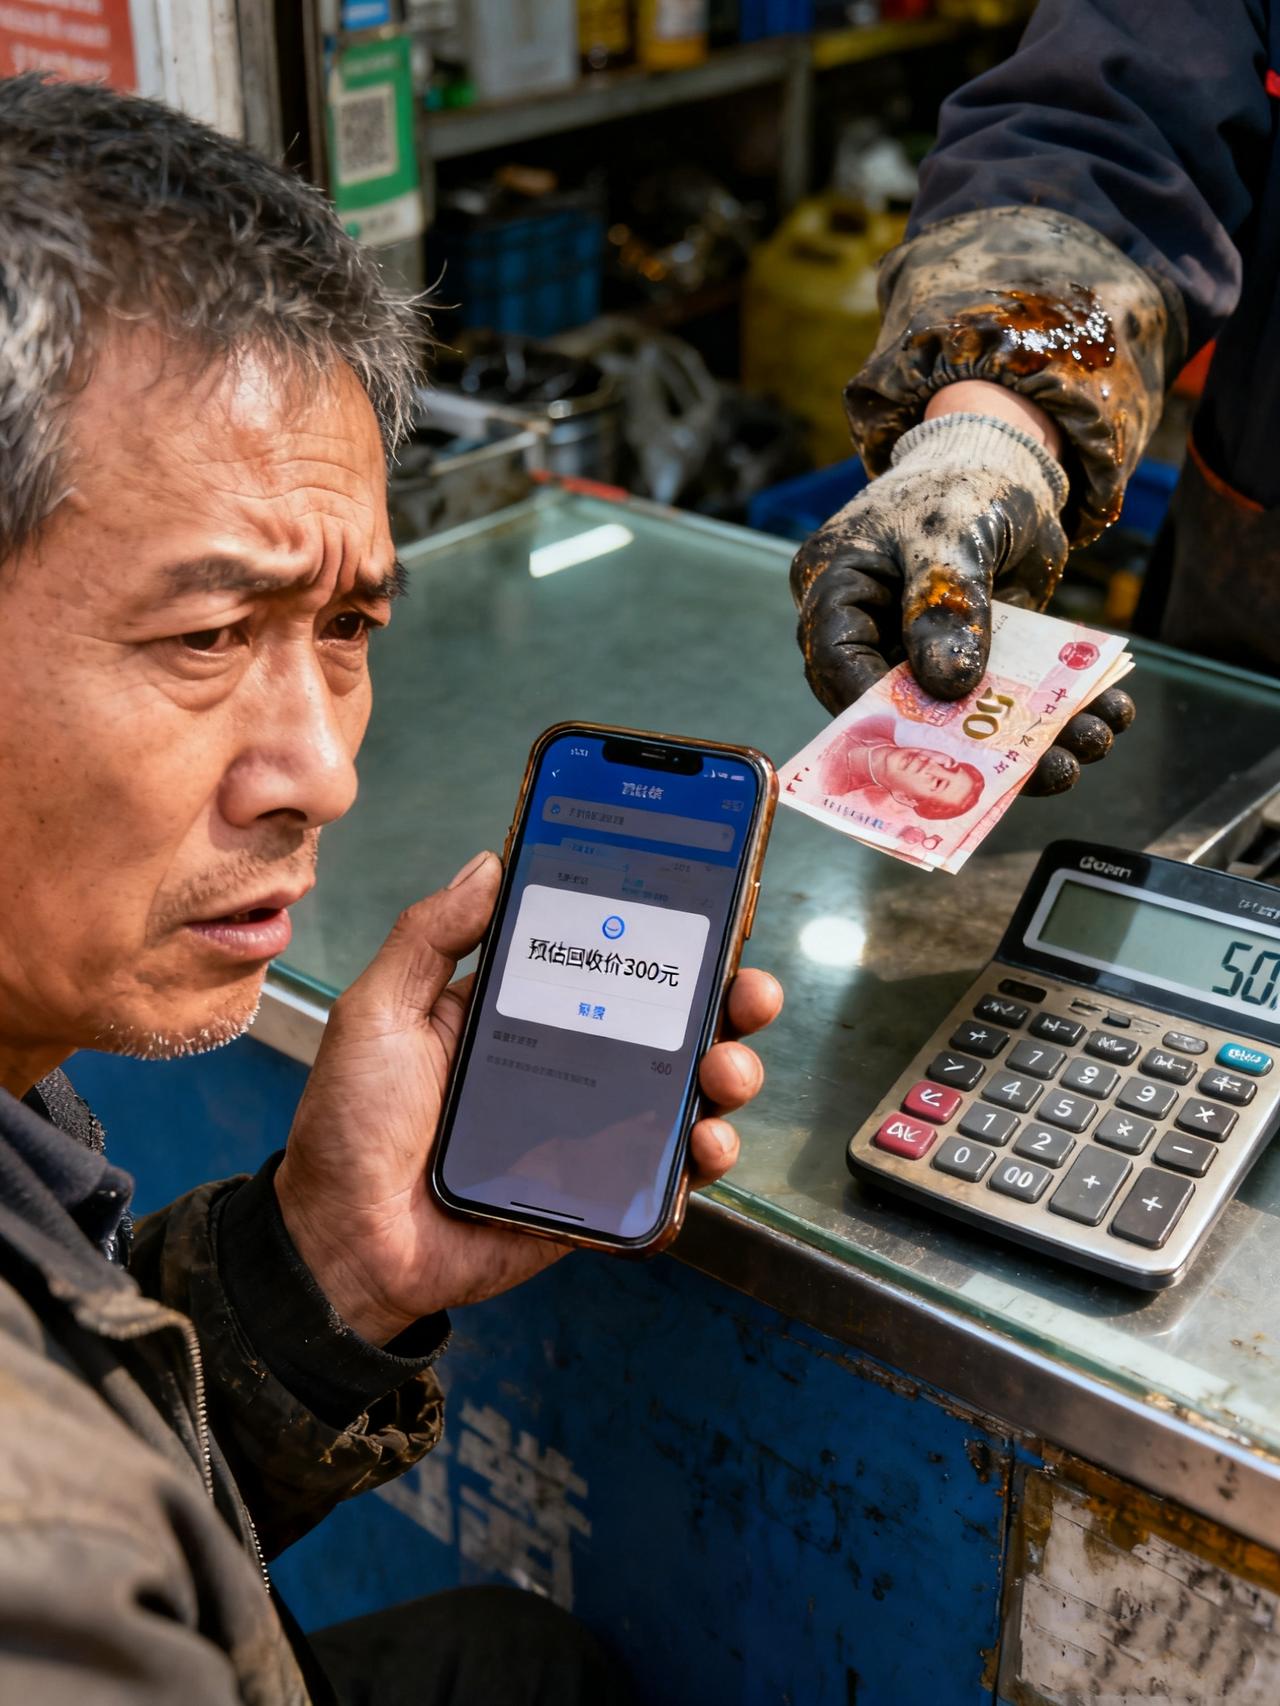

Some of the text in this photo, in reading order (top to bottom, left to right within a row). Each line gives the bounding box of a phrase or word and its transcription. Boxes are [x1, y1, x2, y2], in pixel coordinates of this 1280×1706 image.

[527, 938, 680, 987] 预估回收价300元
[1029, 1050, 1044, 1065] 7
[1001, 1081, 1021, 1100] 4
[1136, 1085, 1156, 1102] 9
[1054, 1099, 1075, 1117] 5
[1031, 1132, 1051, 1150] 2
[953, 1146, 970, 1163] 0
[1003, 1166, 1033, 1188] 00
